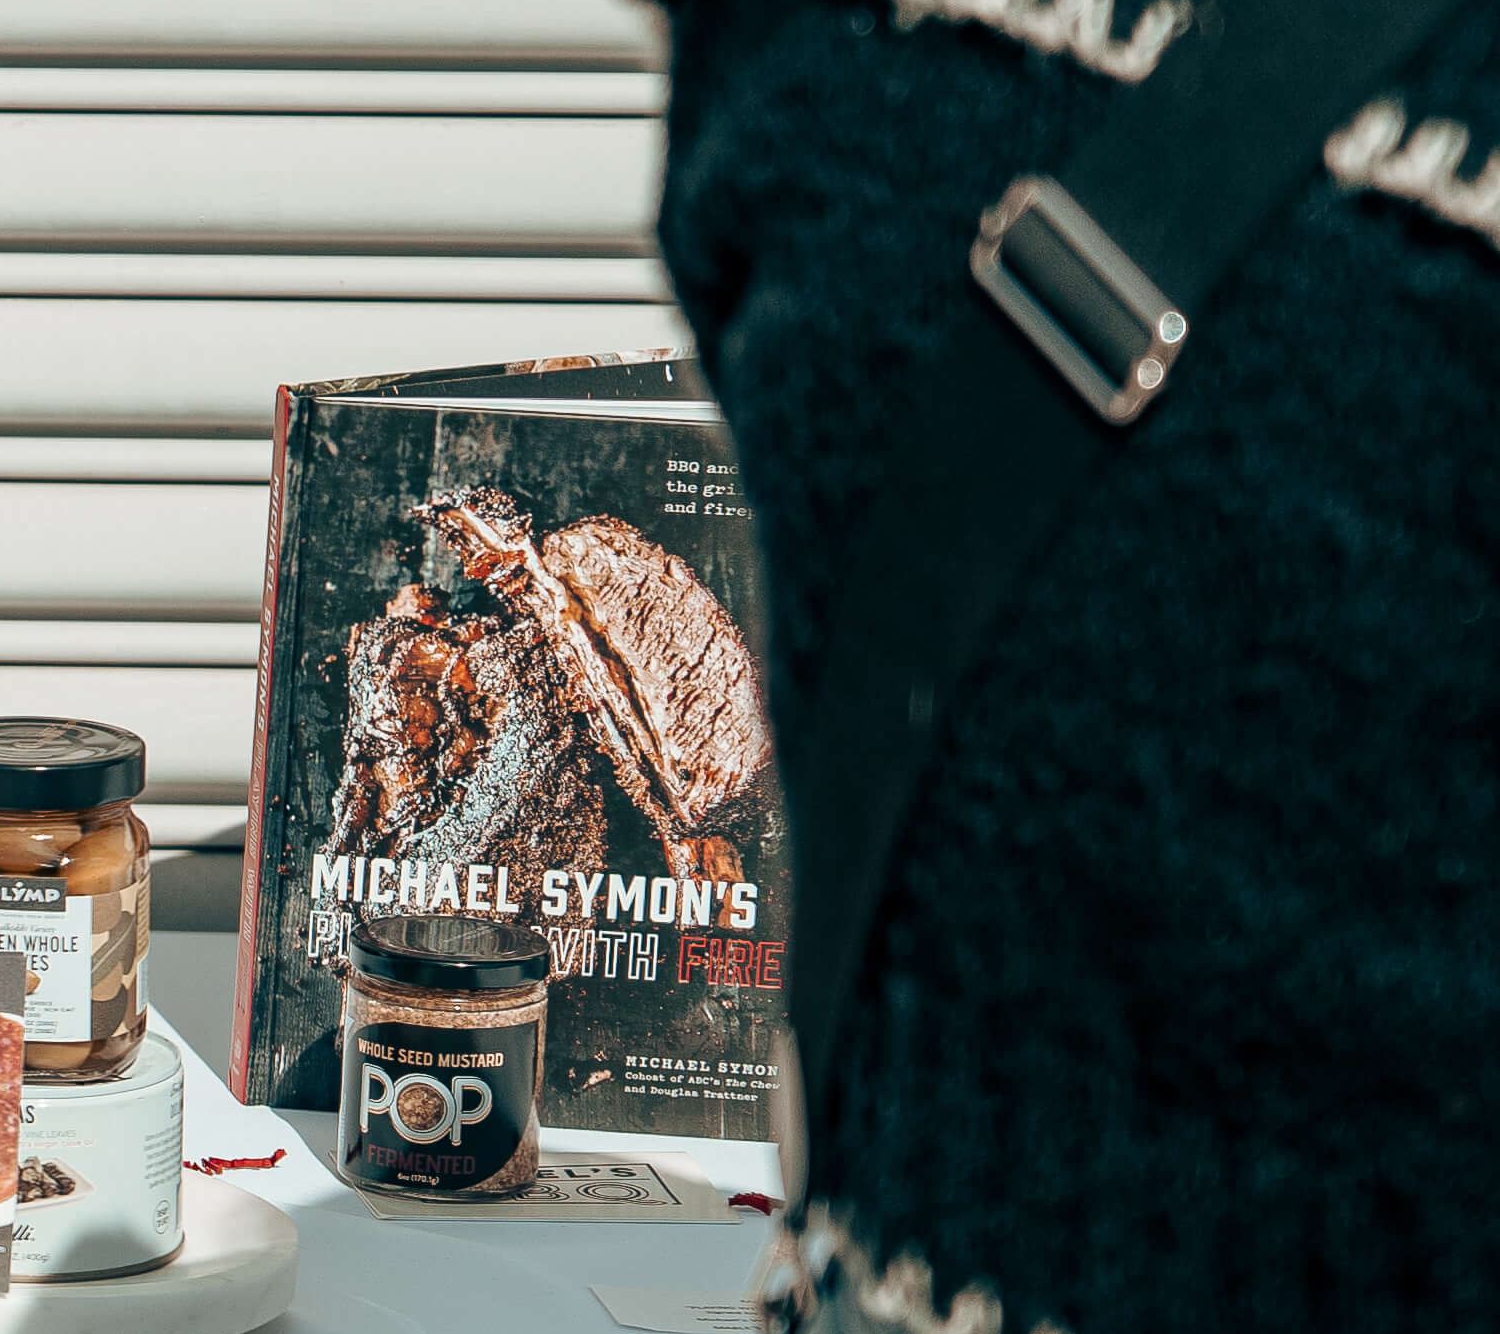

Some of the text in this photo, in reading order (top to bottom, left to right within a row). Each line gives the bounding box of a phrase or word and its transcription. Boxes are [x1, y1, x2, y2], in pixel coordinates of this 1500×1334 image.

[666, 459, 700, 475] BBQ
[666, 480, 698, 494] the
[663, 501, 697, 514] and
[265, 474, 280, 596] MICHAEL
[310, 853, 758, 929] MICHAEL SYMON'S
[24, 934, 79, 952] WHOLE
[550, 927, 786, 989] WITH FIRE
[358, 1037, 505, 1068] WHOLE SEED MUSTARD
[625, 1055, 780, 1077] MICHAEL SYMON
[625, 1071, 665, 1082] Cohost
[670, 1074, 684, 1083] of
[725, 1078, 747, 1088] The
[359, 1062, 493, 1147] POP
[624, 1085, 759, 1102] and Douglas Trattner
[367, 1144, 476, 1176] FERMENTED
